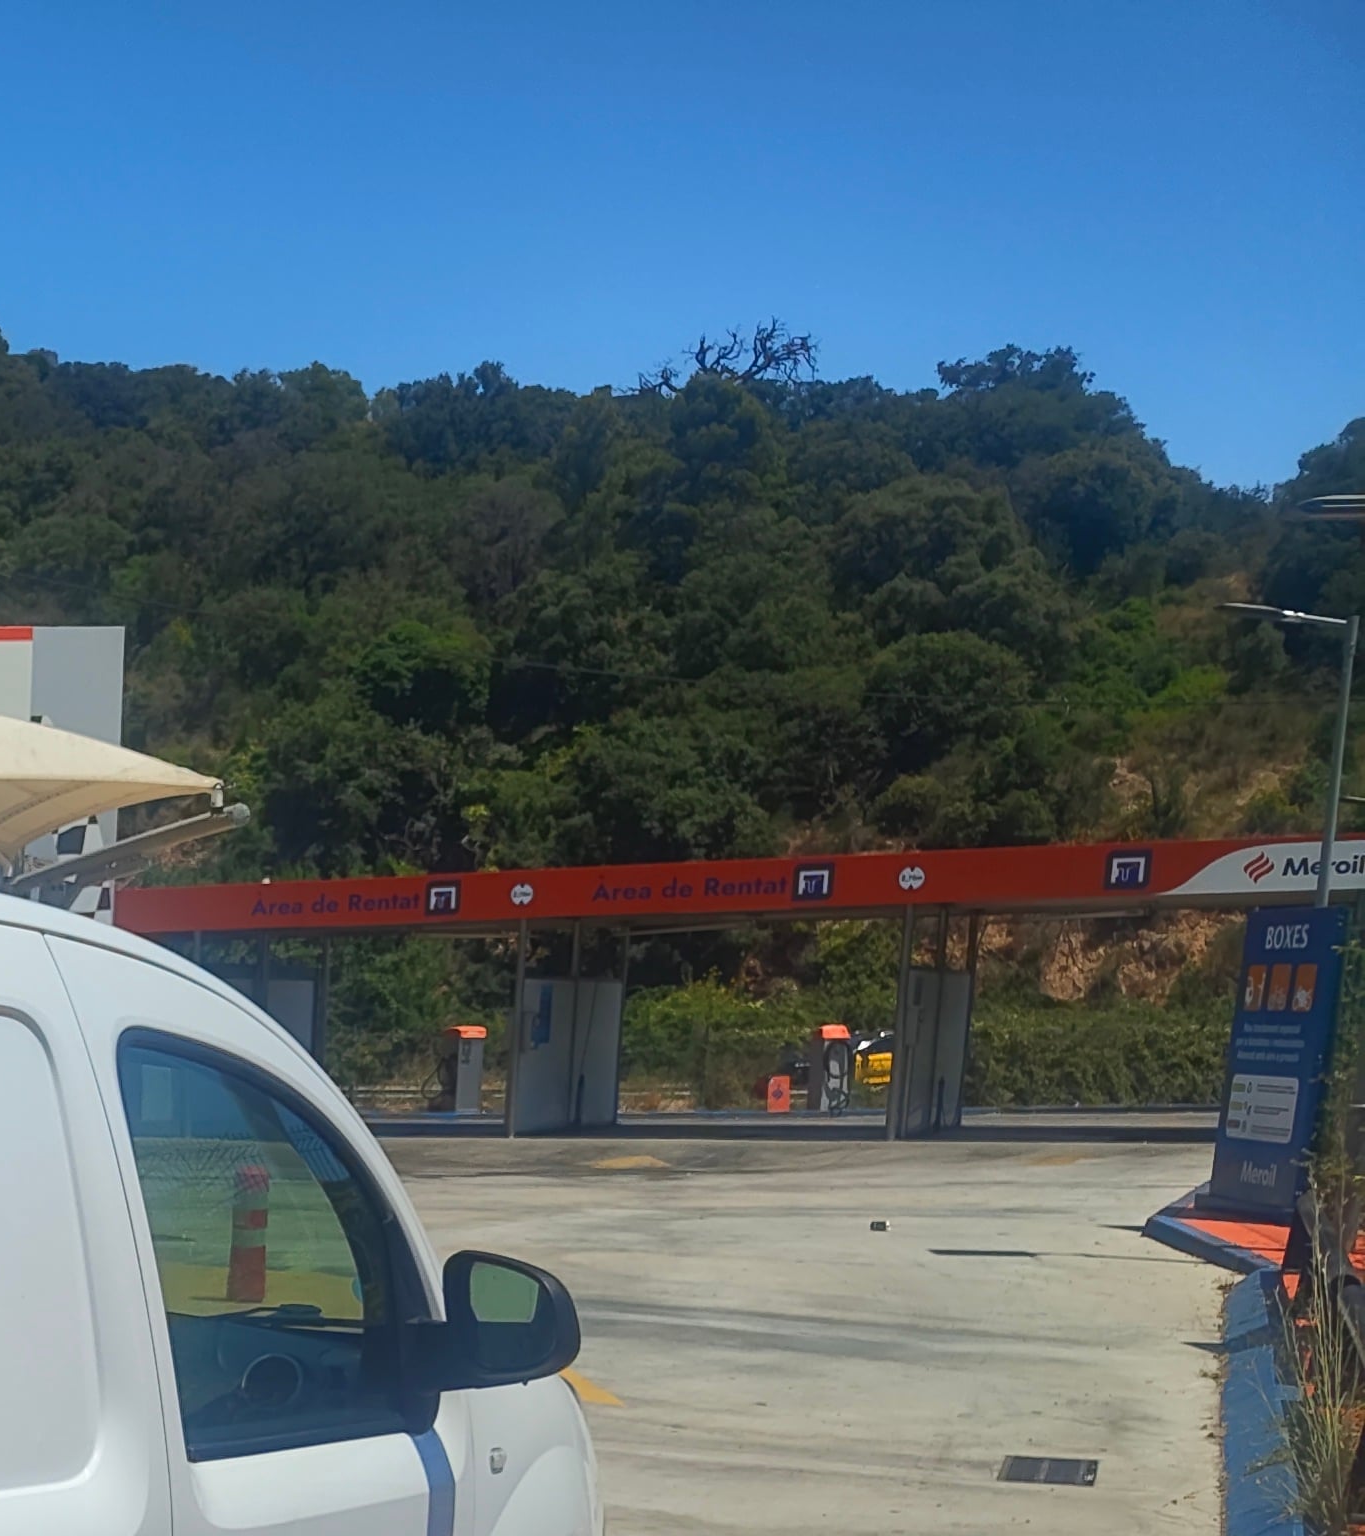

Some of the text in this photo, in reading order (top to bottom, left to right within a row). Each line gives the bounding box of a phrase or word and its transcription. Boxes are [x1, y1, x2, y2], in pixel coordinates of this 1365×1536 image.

[1282, 854, 1365, 876] Meoil
[661, 875, 694, 898] de
[703, 876, 788, 897] Rentat
[311, 893, 339, 914] de
[347, 892, 420, 912] Rentat
[1265, 924, 1310, 949] BOXES
[1239, 1160, 1278, 1187] Meroil
